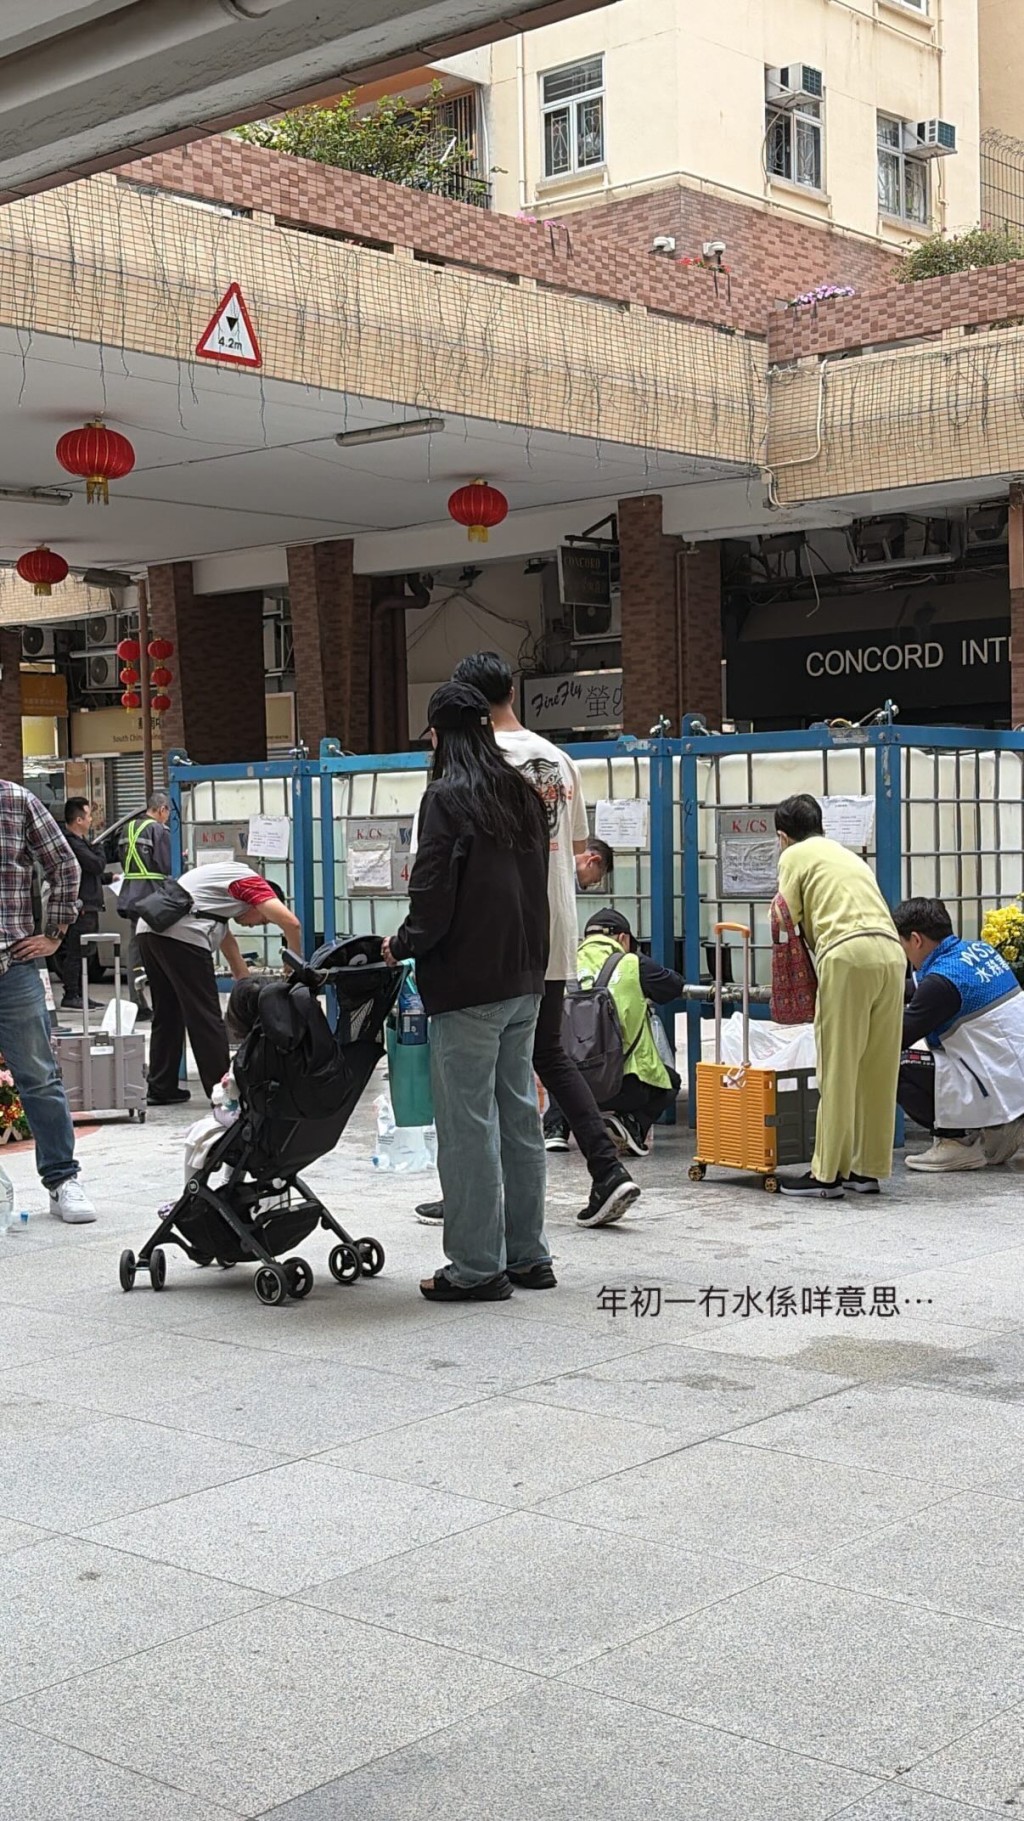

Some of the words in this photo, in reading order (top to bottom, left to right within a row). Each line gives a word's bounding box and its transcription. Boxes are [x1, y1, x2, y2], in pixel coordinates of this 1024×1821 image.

[217, 336, 243, 350] 4.2m
[806, 642, 944, 677] CONCORD
[531, 680, 582, 718] FireFly
[401, 864, 409, 881] 4
